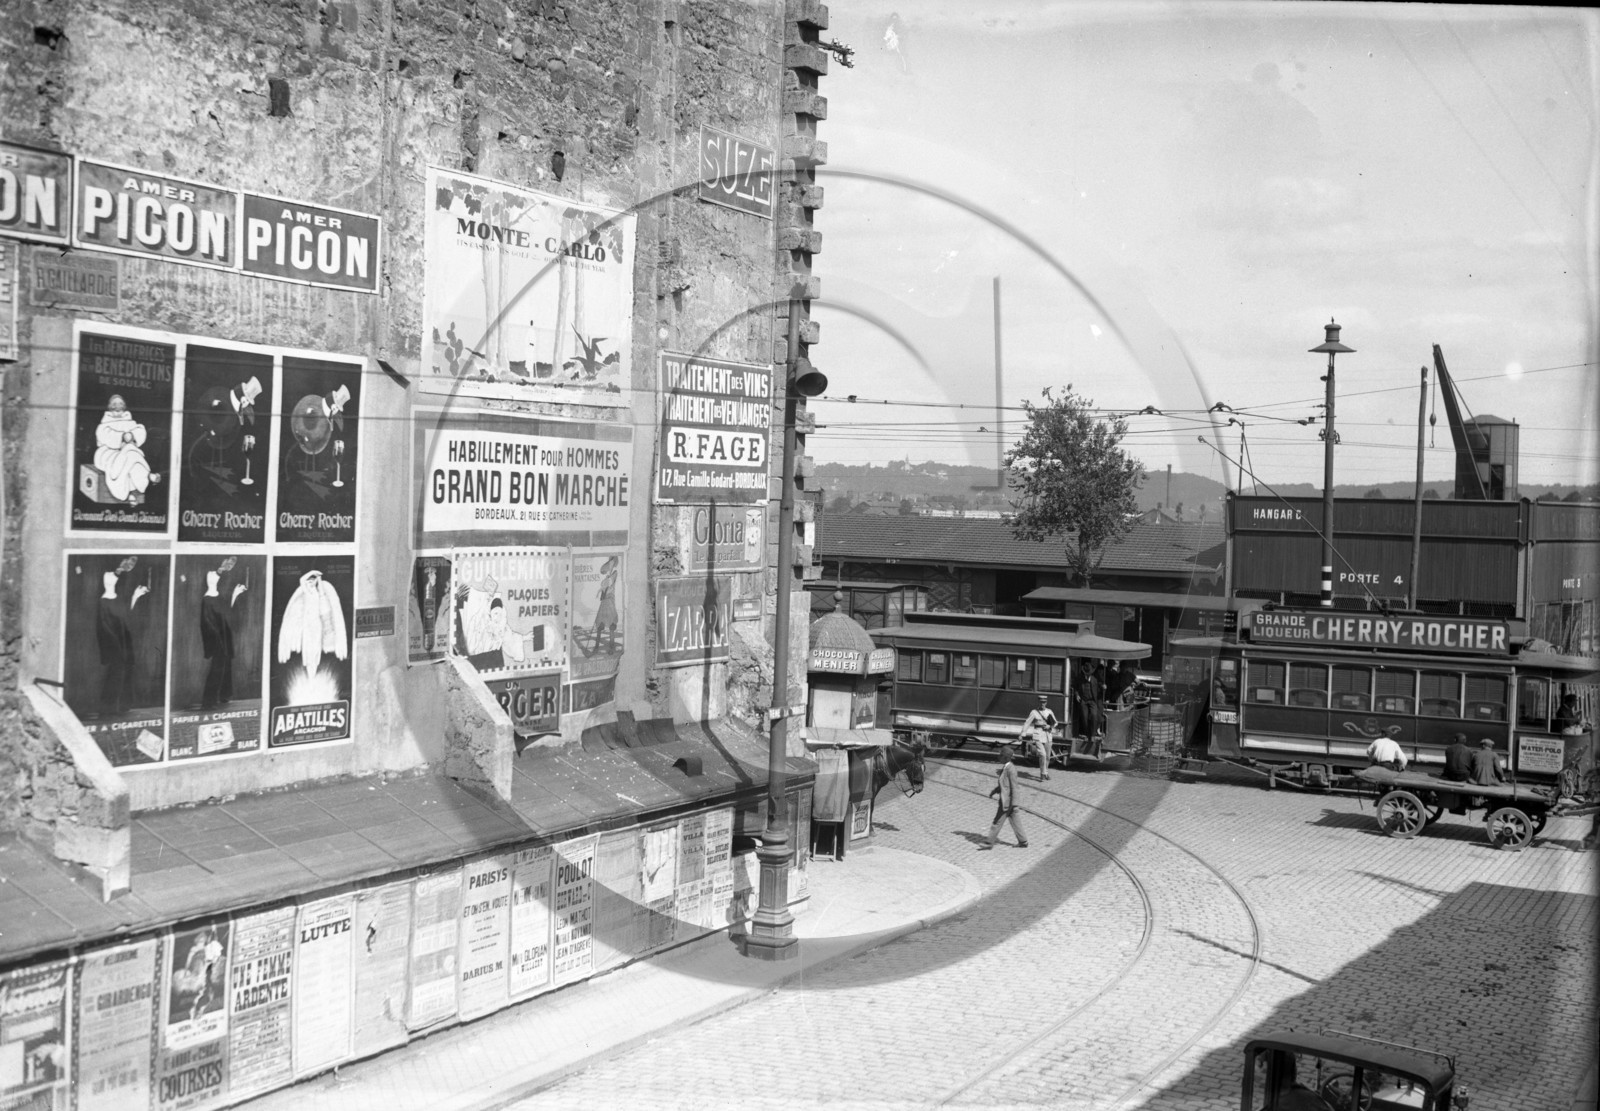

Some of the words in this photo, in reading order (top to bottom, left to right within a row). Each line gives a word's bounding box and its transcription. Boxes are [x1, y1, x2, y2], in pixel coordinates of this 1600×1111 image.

[702, 136, 773, 206] SUZE
[124, 177, 195, 203] AMER
[84, 185, 226, 257] PICON
[280, 208, 342, 229] AMER
[248, 217, 368, 278] PICON
[456, 217, 531, 249] MONTE
[544, 237, 606, 263] CARLO
[112, 376, 152, 389] SOULAC
[666, 360, 732, 394] TRAITEMENT
[731, 376, 743, 390] DES
[743, 371, 768, 398] VINS
[664, 392, 715, 424] TRAITEMENT
[448, 439, 538, 466] HABILLEMENT
[540, 450, 563, 466] POUR
[566, 447, 619, 470] HOMMES
[432, 469, 503, 504] GRAND
[509, 471, 549, 505] BON
[555, 472, 628, 507] MARCHÉ
[673, 469, 686, 487] Rue
[687, 469, 710, 488] Camille
[182, 510, 222, 530] Cherry
[224, 510, 263, 530] Rocher
[279, 511, 316, 530] Cherry
[318, 512, 353, 530] Rocher
[528, 511, 541, 521] RUE
[549, 511, 578, 521] CATHERINE
[1253, 508, 1294, 520] HANGAR
[694, 507, 745, 547] Gloria
[1339, 572, 1380, 584] PORTE
[1393, 575, 1403, 585] 4
[508, 589, 550, 603] PLAQUES
[356, 613, 394, 626] GAILLARD
[518, 604, 560, 618] PAPIERS
[1256, 614, 1306, 627] GRANDE
[660, 595, 729, 653] IZARRA
[1253, 626, 1312, 640] LIQUEUR
[1311, 616, 1506, 650] CHERRY-ROCHER
[812, 648, 860, 661] CHOCOLAT
[814, 659, 858, 672] MENIER
[496, 686, 557, 721] RGER
[100, 723, 108, 732] A
[112, 718, 163, 731] CIGARETTES
[172, 714, 200, 724] PAPIER
[212, 709, 258, 720] CIGARETTES
[273, 707, 346, 737] ABATILLES
[293, 726, 327, 736] ARCACHON
[171, 747, 193, 757] BLANC
[237, 739, 258, 749] BLANC
[683, 831, 704, 842] VILLA
[683, 845, 704, 855] VILLA
[469, 867, 508, 891] PARISYS
[557, 856, 593, 887] POULOT
[300, 917, 351, 944] LUTTE
[555, 947, 569, 960] JEAN
[256, 950, 292, 984] FEMME
[462, 961, 494, 982] DARIUS
[234, 977, 289, 1013] ARDENTE
[159, 1057, 223, 1104] COURSES
